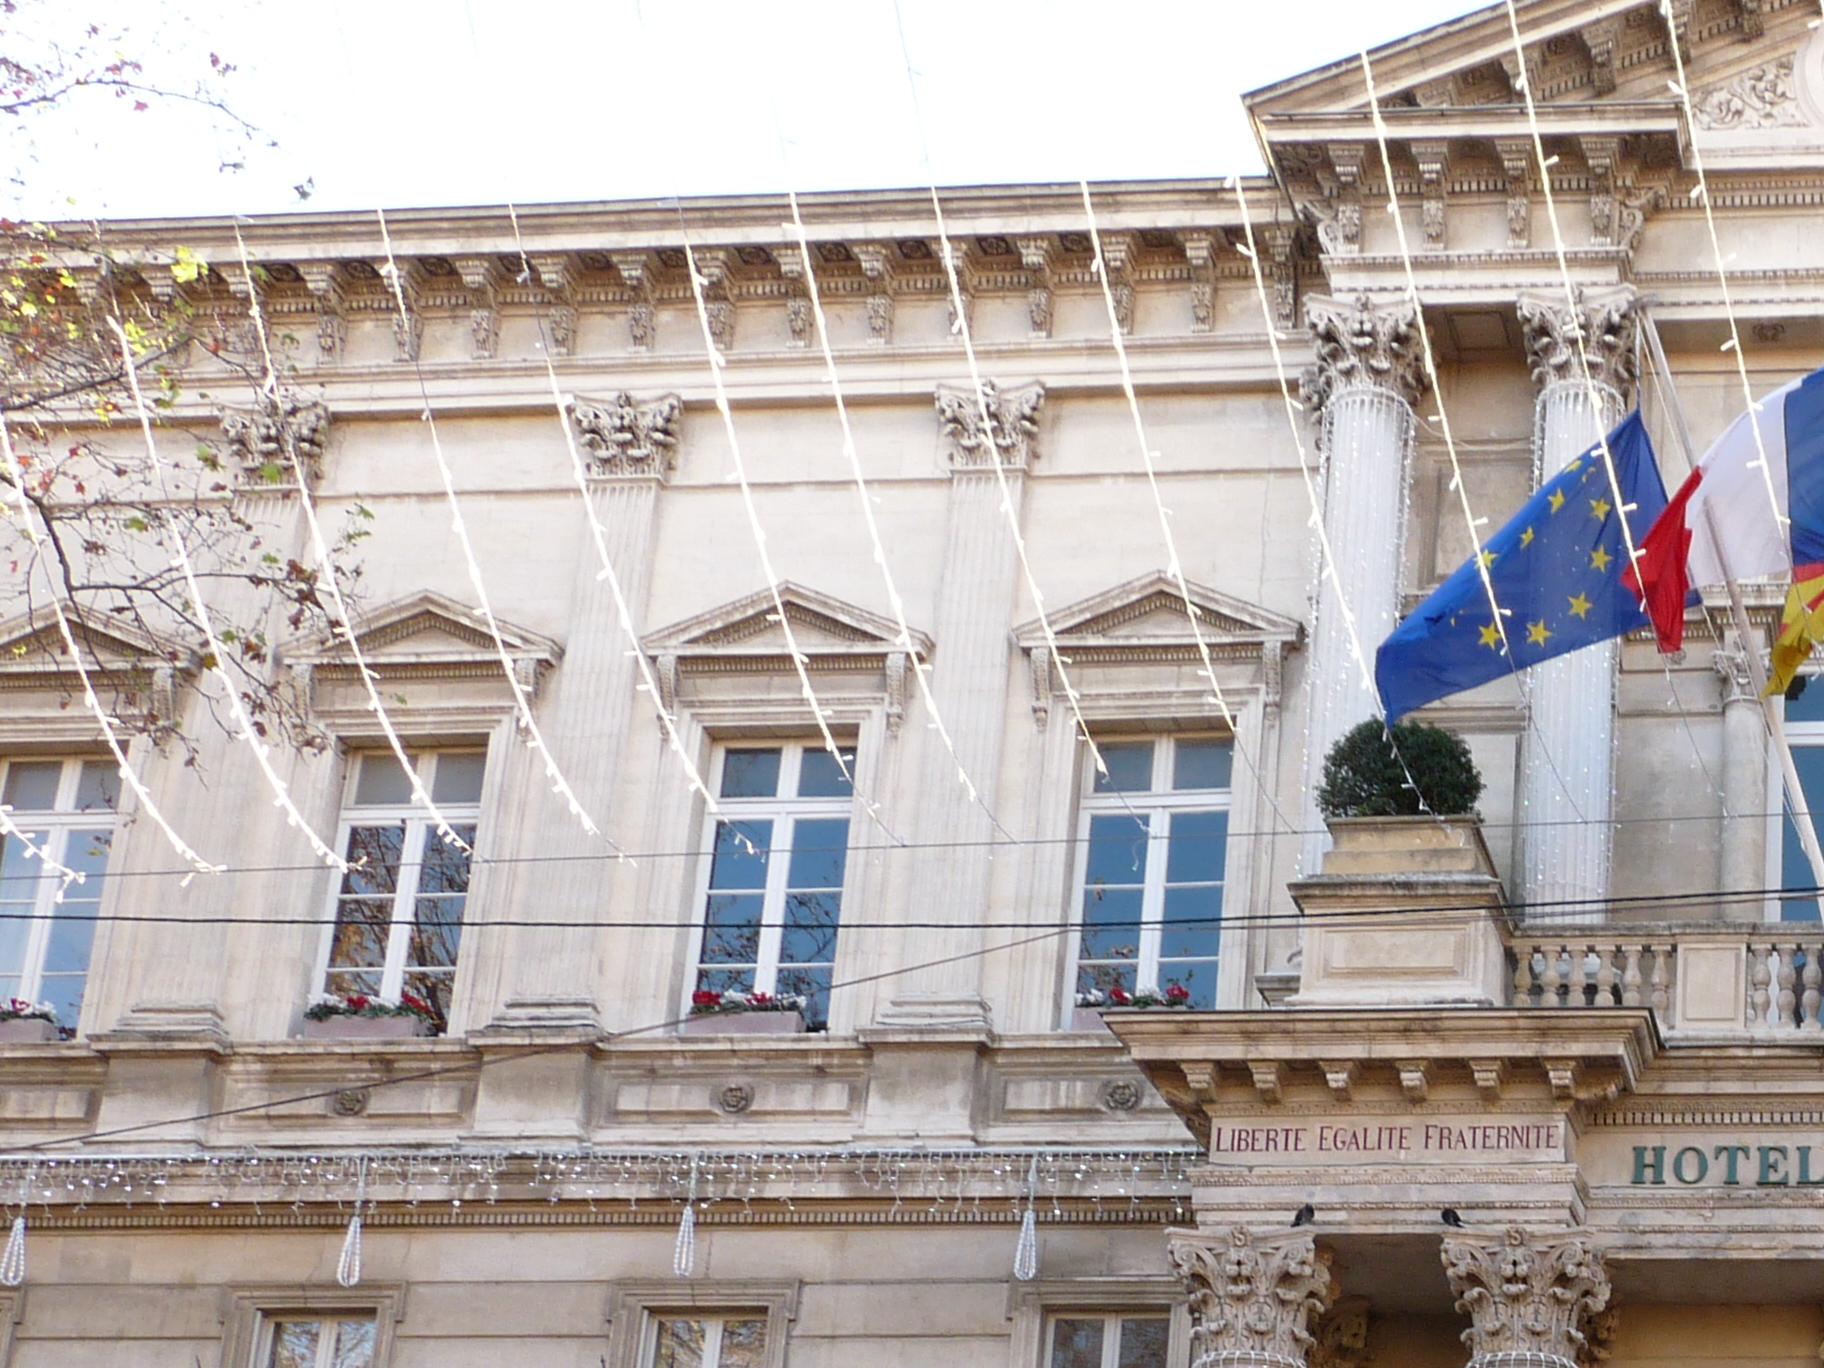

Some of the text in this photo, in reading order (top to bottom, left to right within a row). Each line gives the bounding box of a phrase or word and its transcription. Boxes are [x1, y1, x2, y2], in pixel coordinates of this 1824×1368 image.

[1216, 1124, 1560, 1152] LIBERTE EGALITE FRATERNITE
